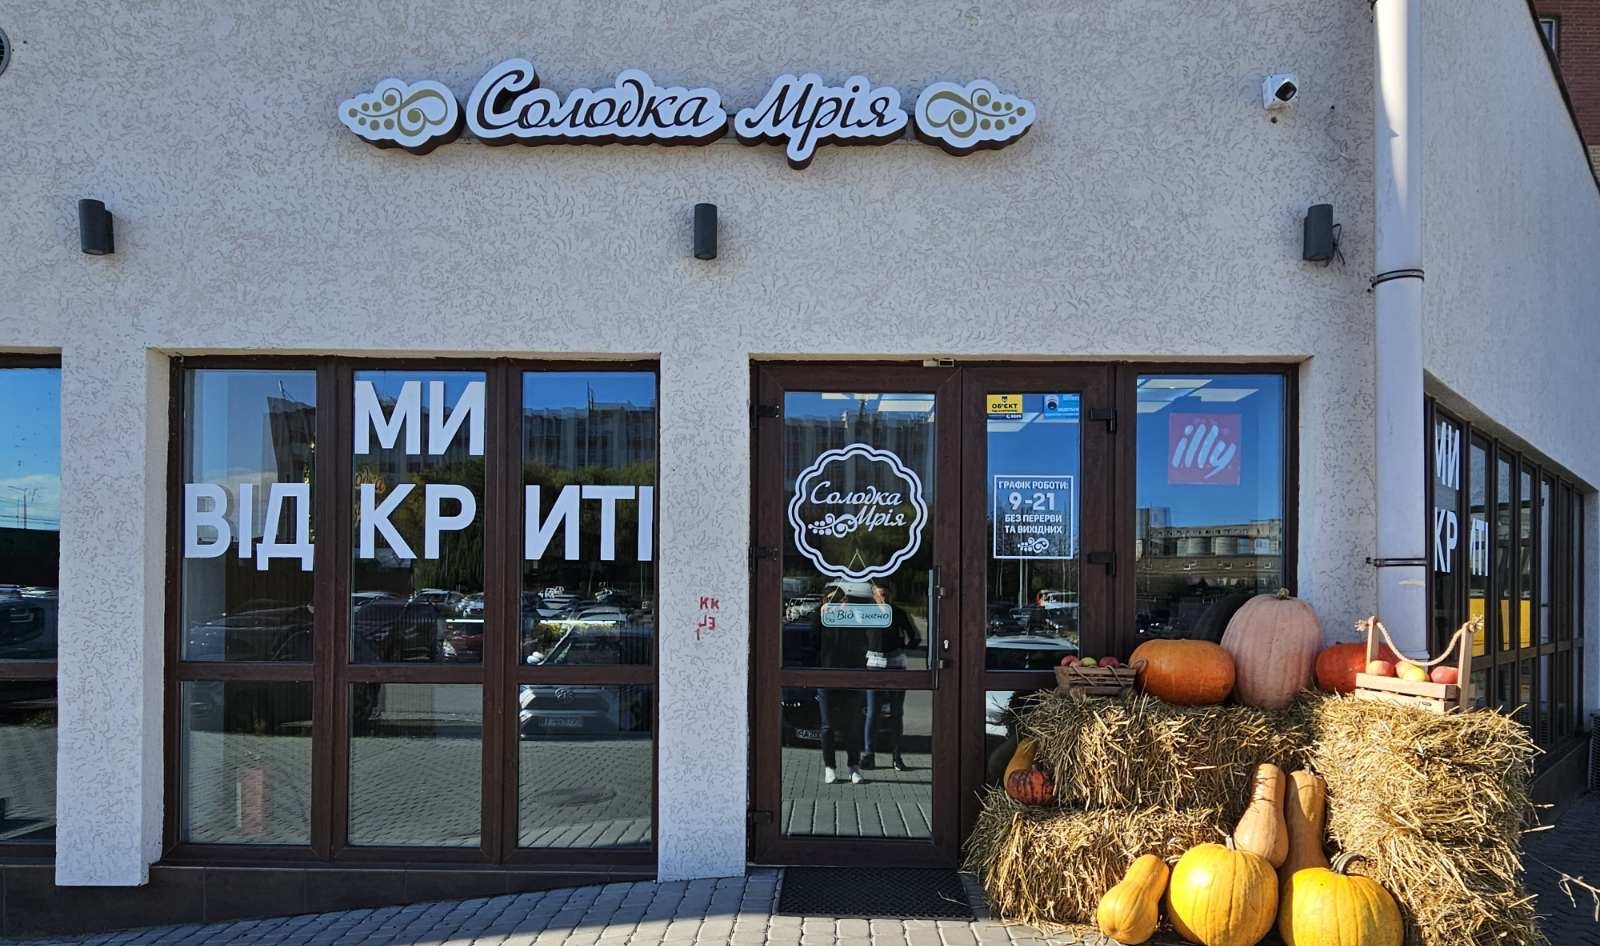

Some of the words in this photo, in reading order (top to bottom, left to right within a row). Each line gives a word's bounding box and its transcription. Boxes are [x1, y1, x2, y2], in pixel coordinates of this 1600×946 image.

[475, 68, 716, 131] Солодка
[743, 82, 898, 152] Мрія
[354, 381, 486, 455] МИ
[1172, 424, 1236, 479] illy
[810, 481, 904, 506] Солодка
[998, 480, 1031, 489] ГРАФІК
[1032, 480, 1069, 490] РОБОТИ:
[848, 505, 907, 532] Мрія
[1004, 514, 1021, 523] БЕЗ
[1022, 514, 1062, 523] ПЕРЕРВИ
[1004, 525, 1016, 534] ТА
[1017, 525, 1062, 535] ВИХІДНИХ
